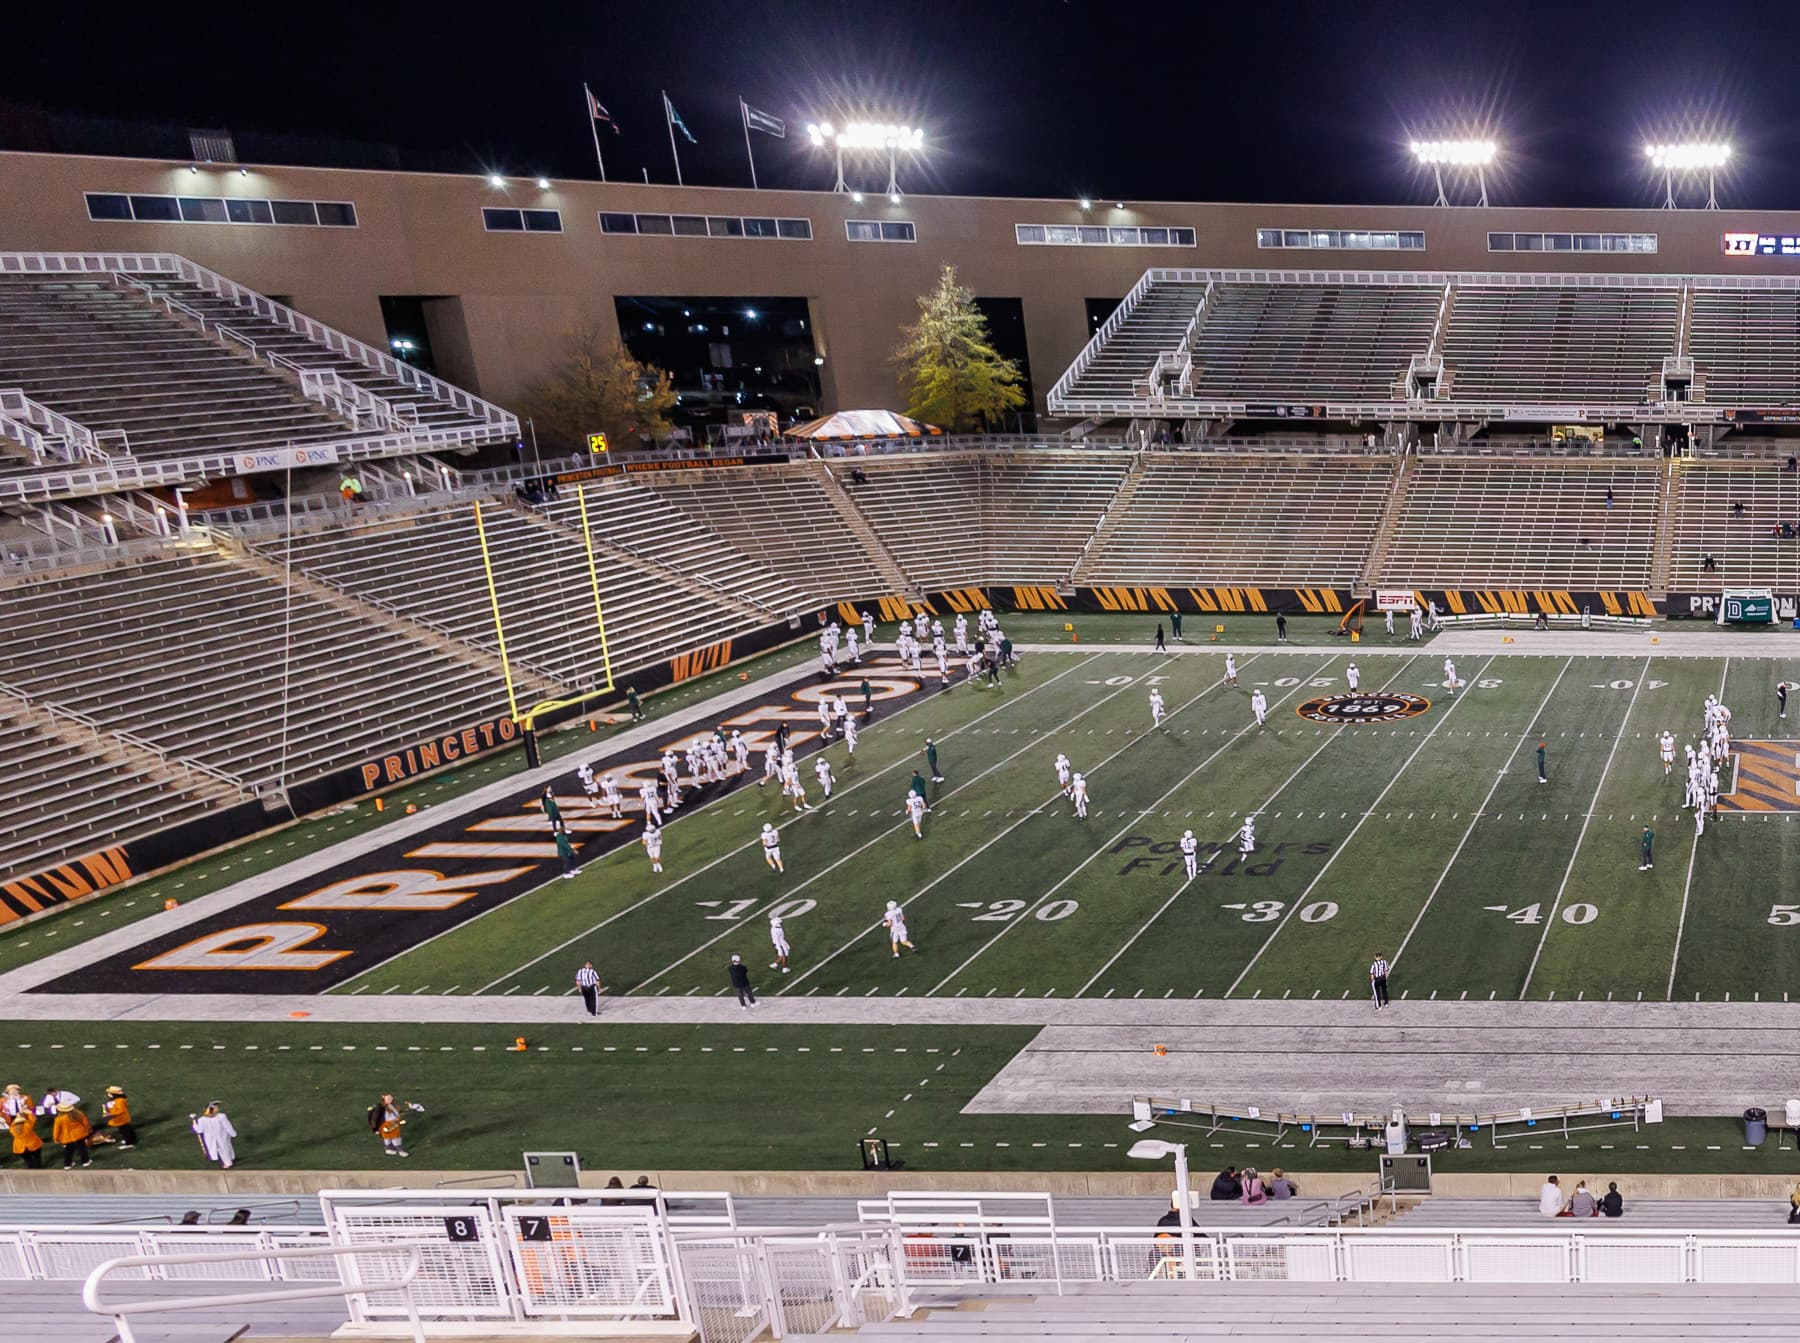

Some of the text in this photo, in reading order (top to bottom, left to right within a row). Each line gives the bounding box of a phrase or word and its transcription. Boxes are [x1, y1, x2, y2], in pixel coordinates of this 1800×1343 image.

[591, 435, 606, 453] 25
[256, 455, 278, 466] PNC
[307, 449, 328, 460] PNC
[662, 460, 709, 470] FOOTBALL
[1379, 595, 1412, 604] ESPN
[1728, 601, 1742, 618] D
[1327, 704, 1400, 713] 1869
[704, 898, 818, 921] 10
[969, 899, 1080, 922] 20
[1241, 900, 1340, 923] 30
[1505, 902, 1600, 925] 40
[454, 1220, 467, 1236] 8
[526, 1220, 539, 1236] 7
[956, 1247, 964, 1258] 7
